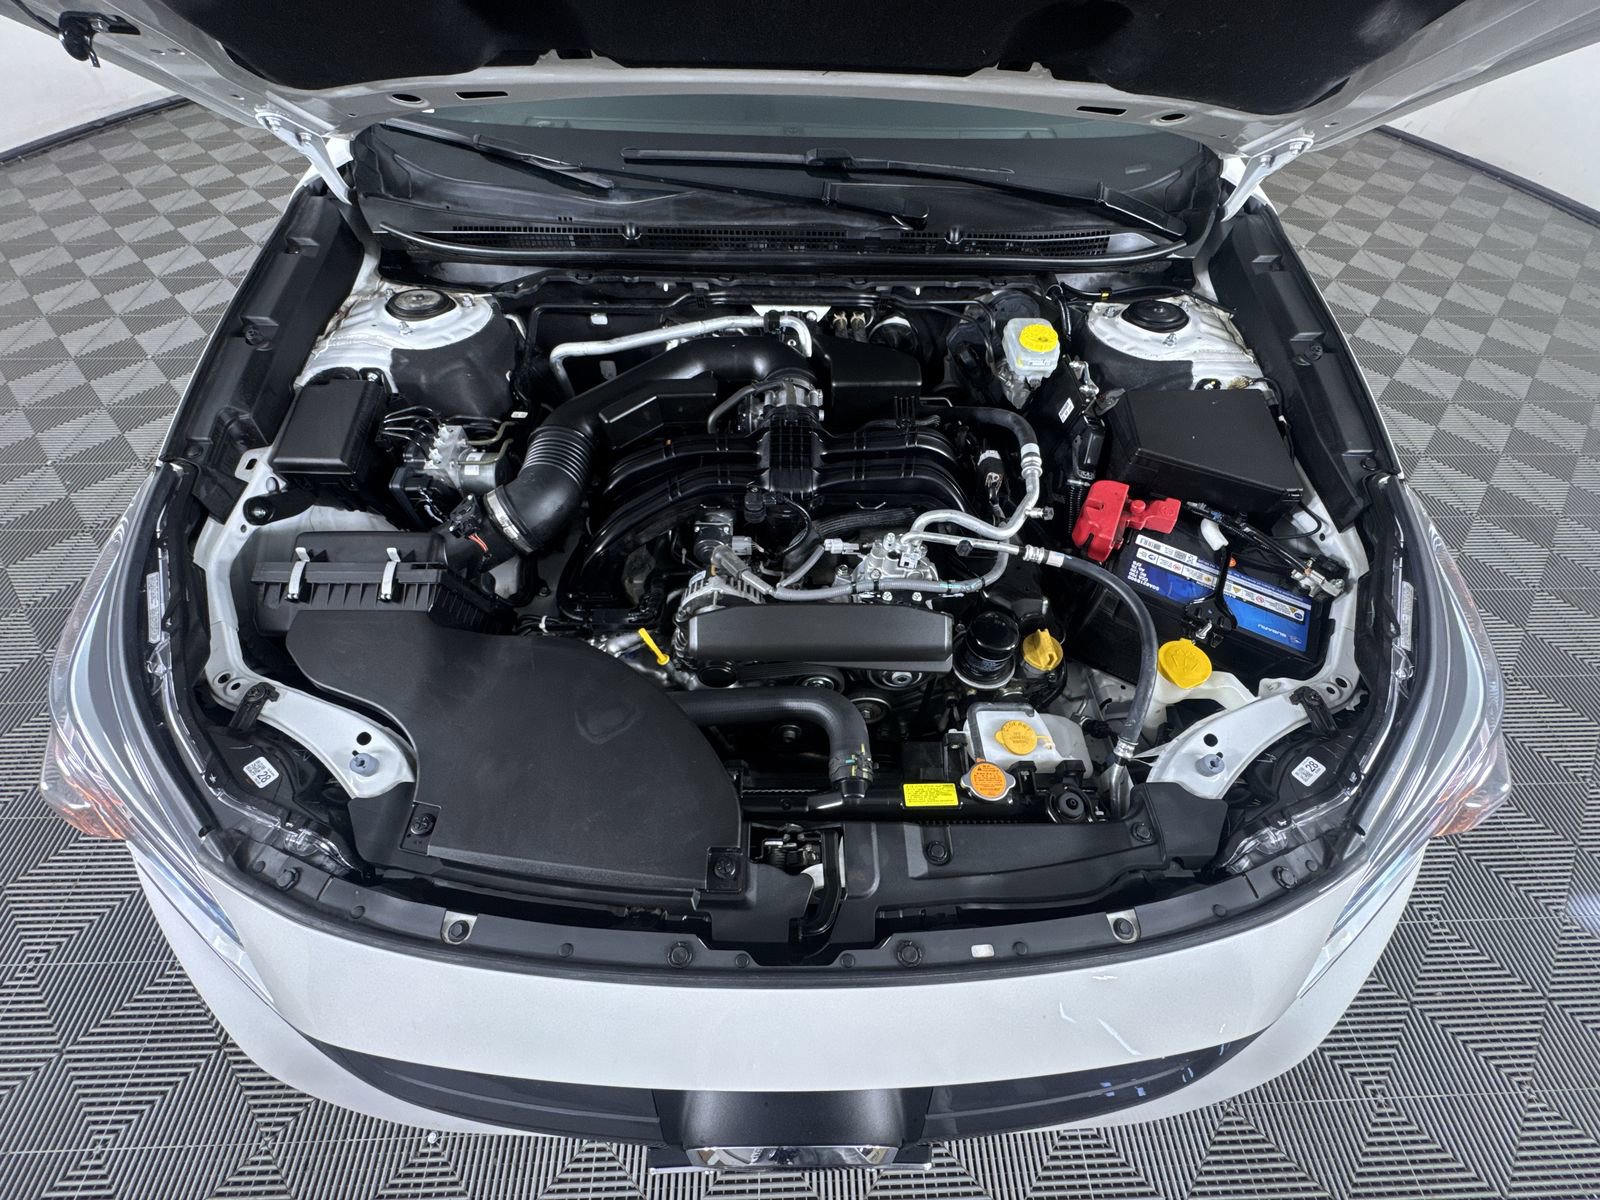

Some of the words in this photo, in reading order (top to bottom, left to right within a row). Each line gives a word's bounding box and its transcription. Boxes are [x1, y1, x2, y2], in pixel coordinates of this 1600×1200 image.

[1257, 623, 1287, 637] SUBARU
[1306, 761, 1318, 772] 28
[257, 771, 271, 782] 28
